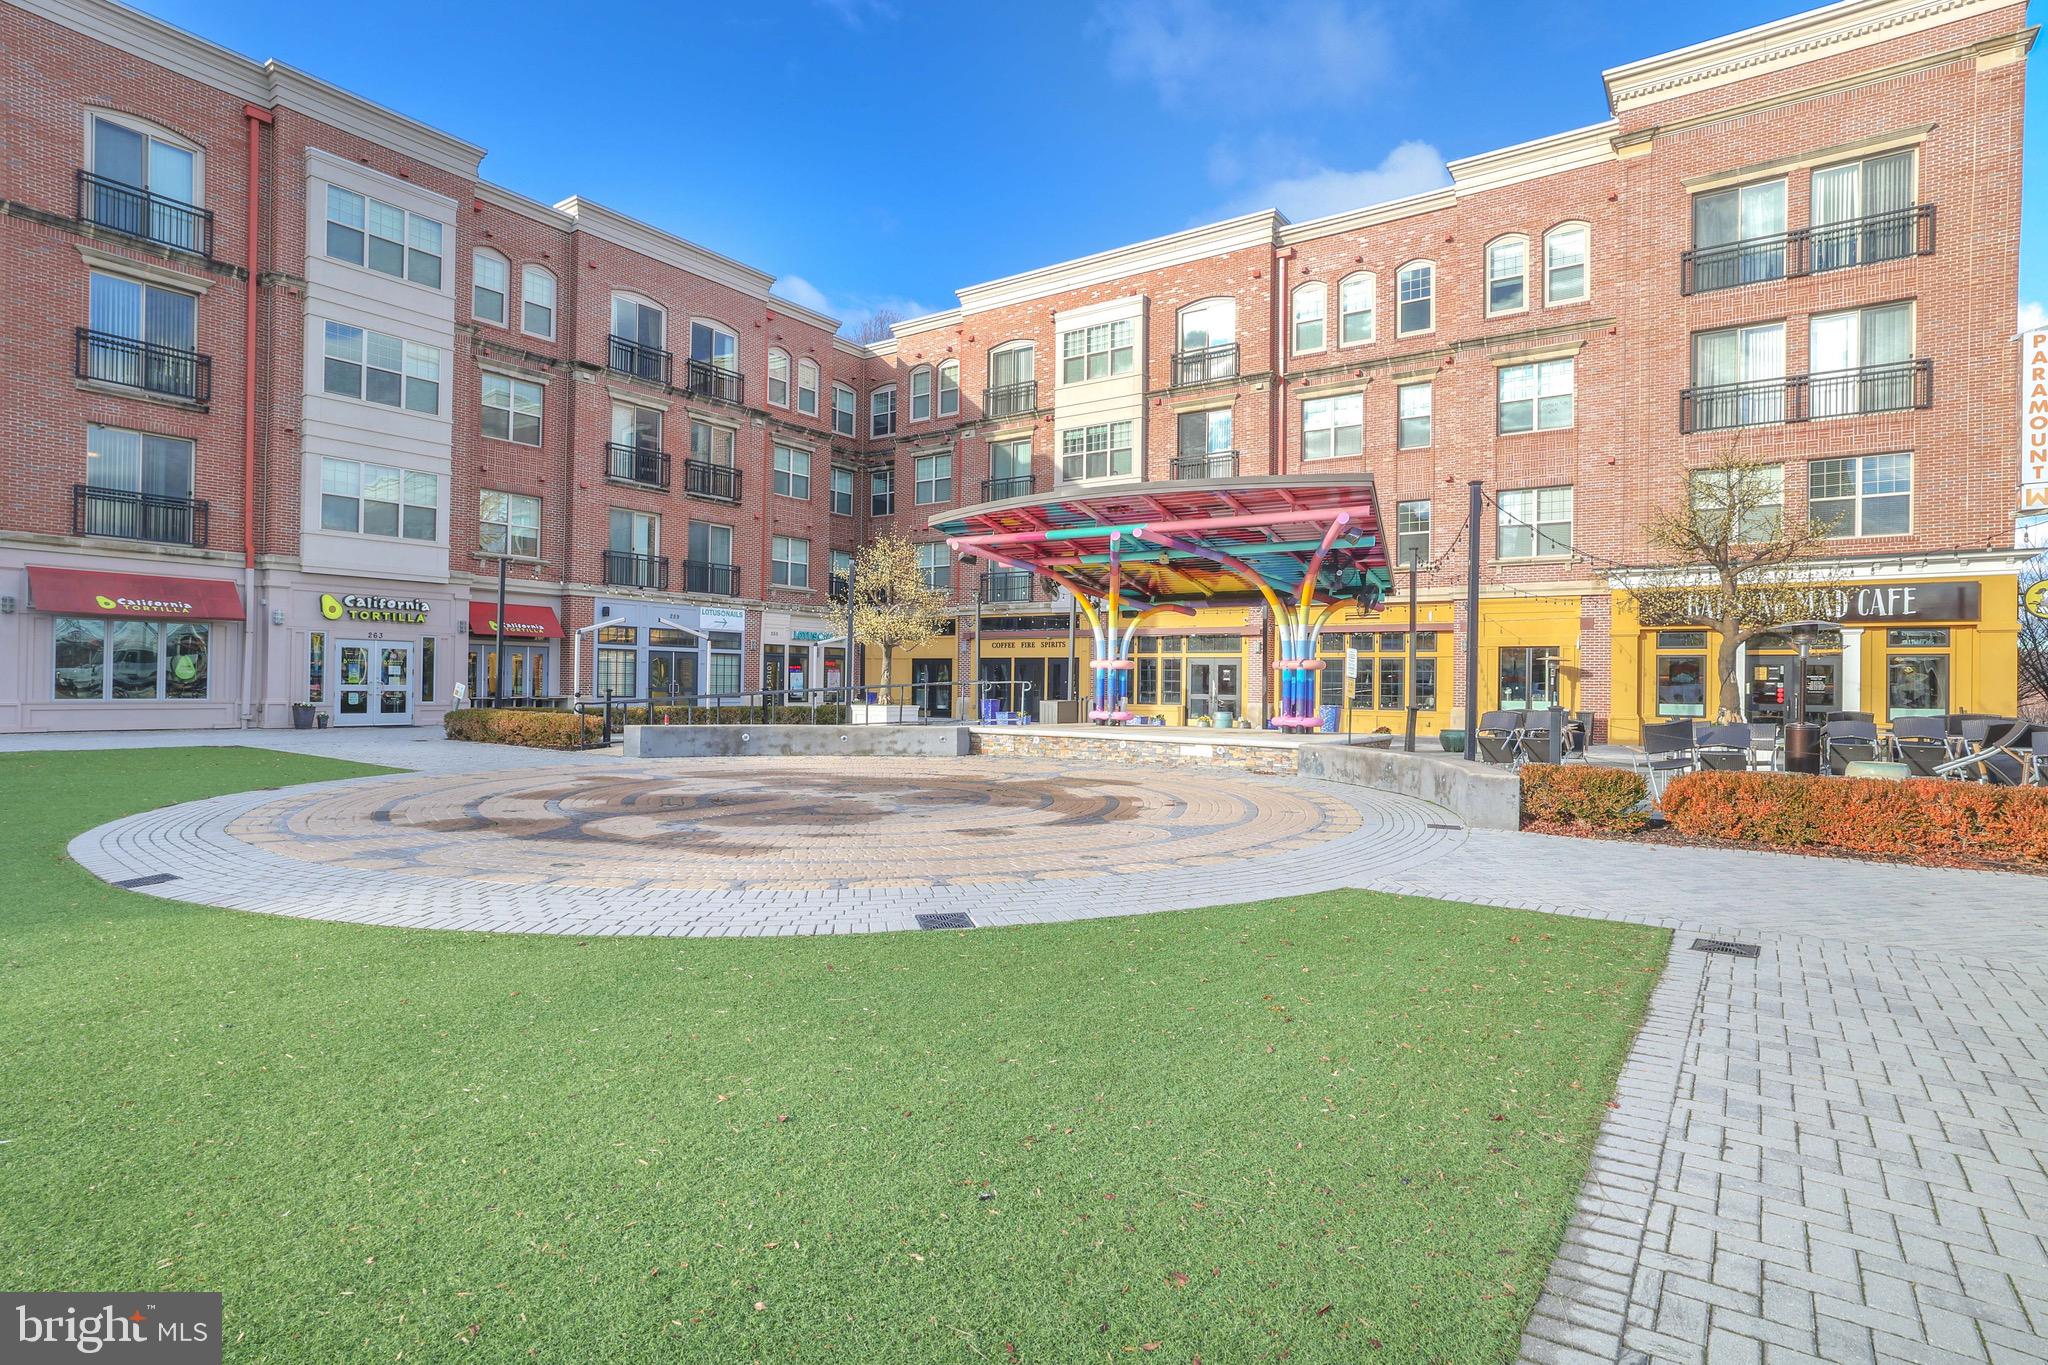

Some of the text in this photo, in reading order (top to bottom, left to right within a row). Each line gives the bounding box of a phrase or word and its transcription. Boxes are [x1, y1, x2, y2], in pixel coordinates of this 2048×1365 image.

[117, 597, 192, 609] California
[343, 594, 430, 612] California
[1857, 586, 1917, 617] CAFE
[124, 605, 190, 613] TORTILLA
[349, 610, 426, 623] TORTILLA
[503, 622, 544, 630] alifornia
